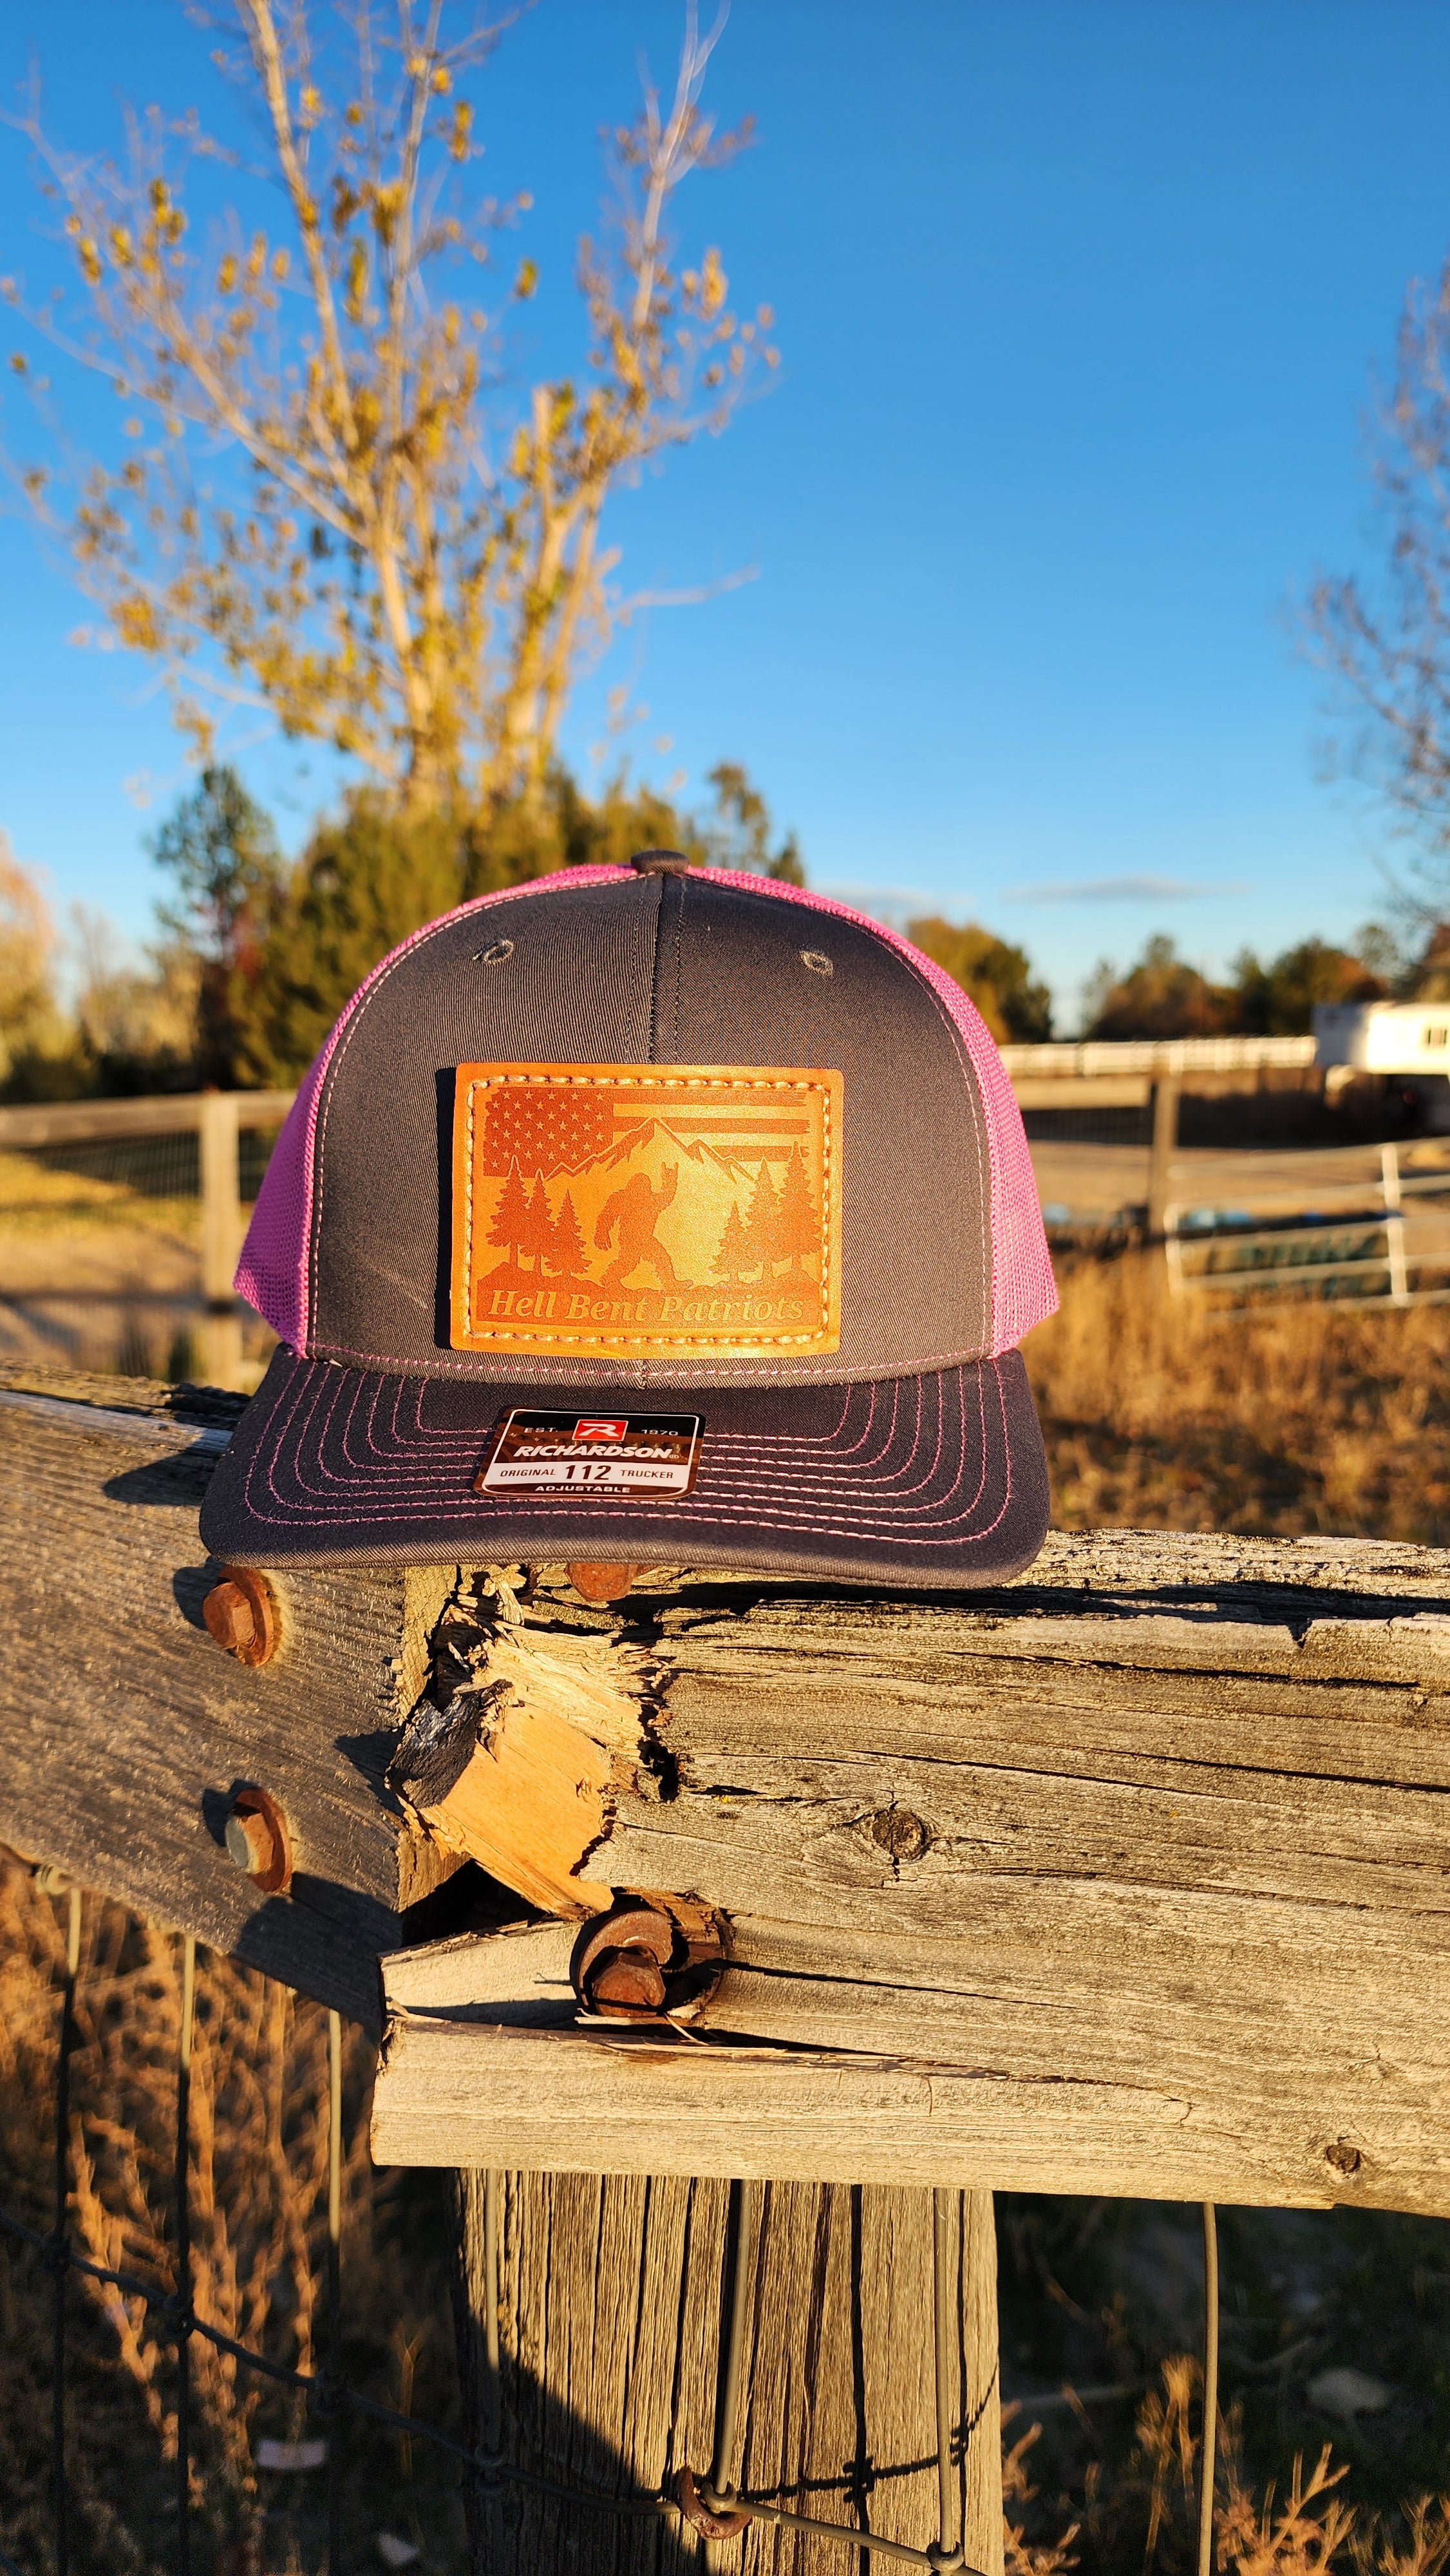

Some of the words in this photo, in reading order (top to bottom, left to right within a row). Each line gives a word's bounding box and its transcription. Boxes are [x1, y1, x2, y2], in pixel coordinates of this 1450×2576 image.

[488, 1289, 556, 1318] Hell
[564, 1294, 649, 1322] Bent
[657, 1294, 806, 1322] Patriots
[500, 1469, 556, 1477] ORIGINAL
[565, 1464, 612, 1480] 112
[620, 1469, 673, 1479] TRUCKER
